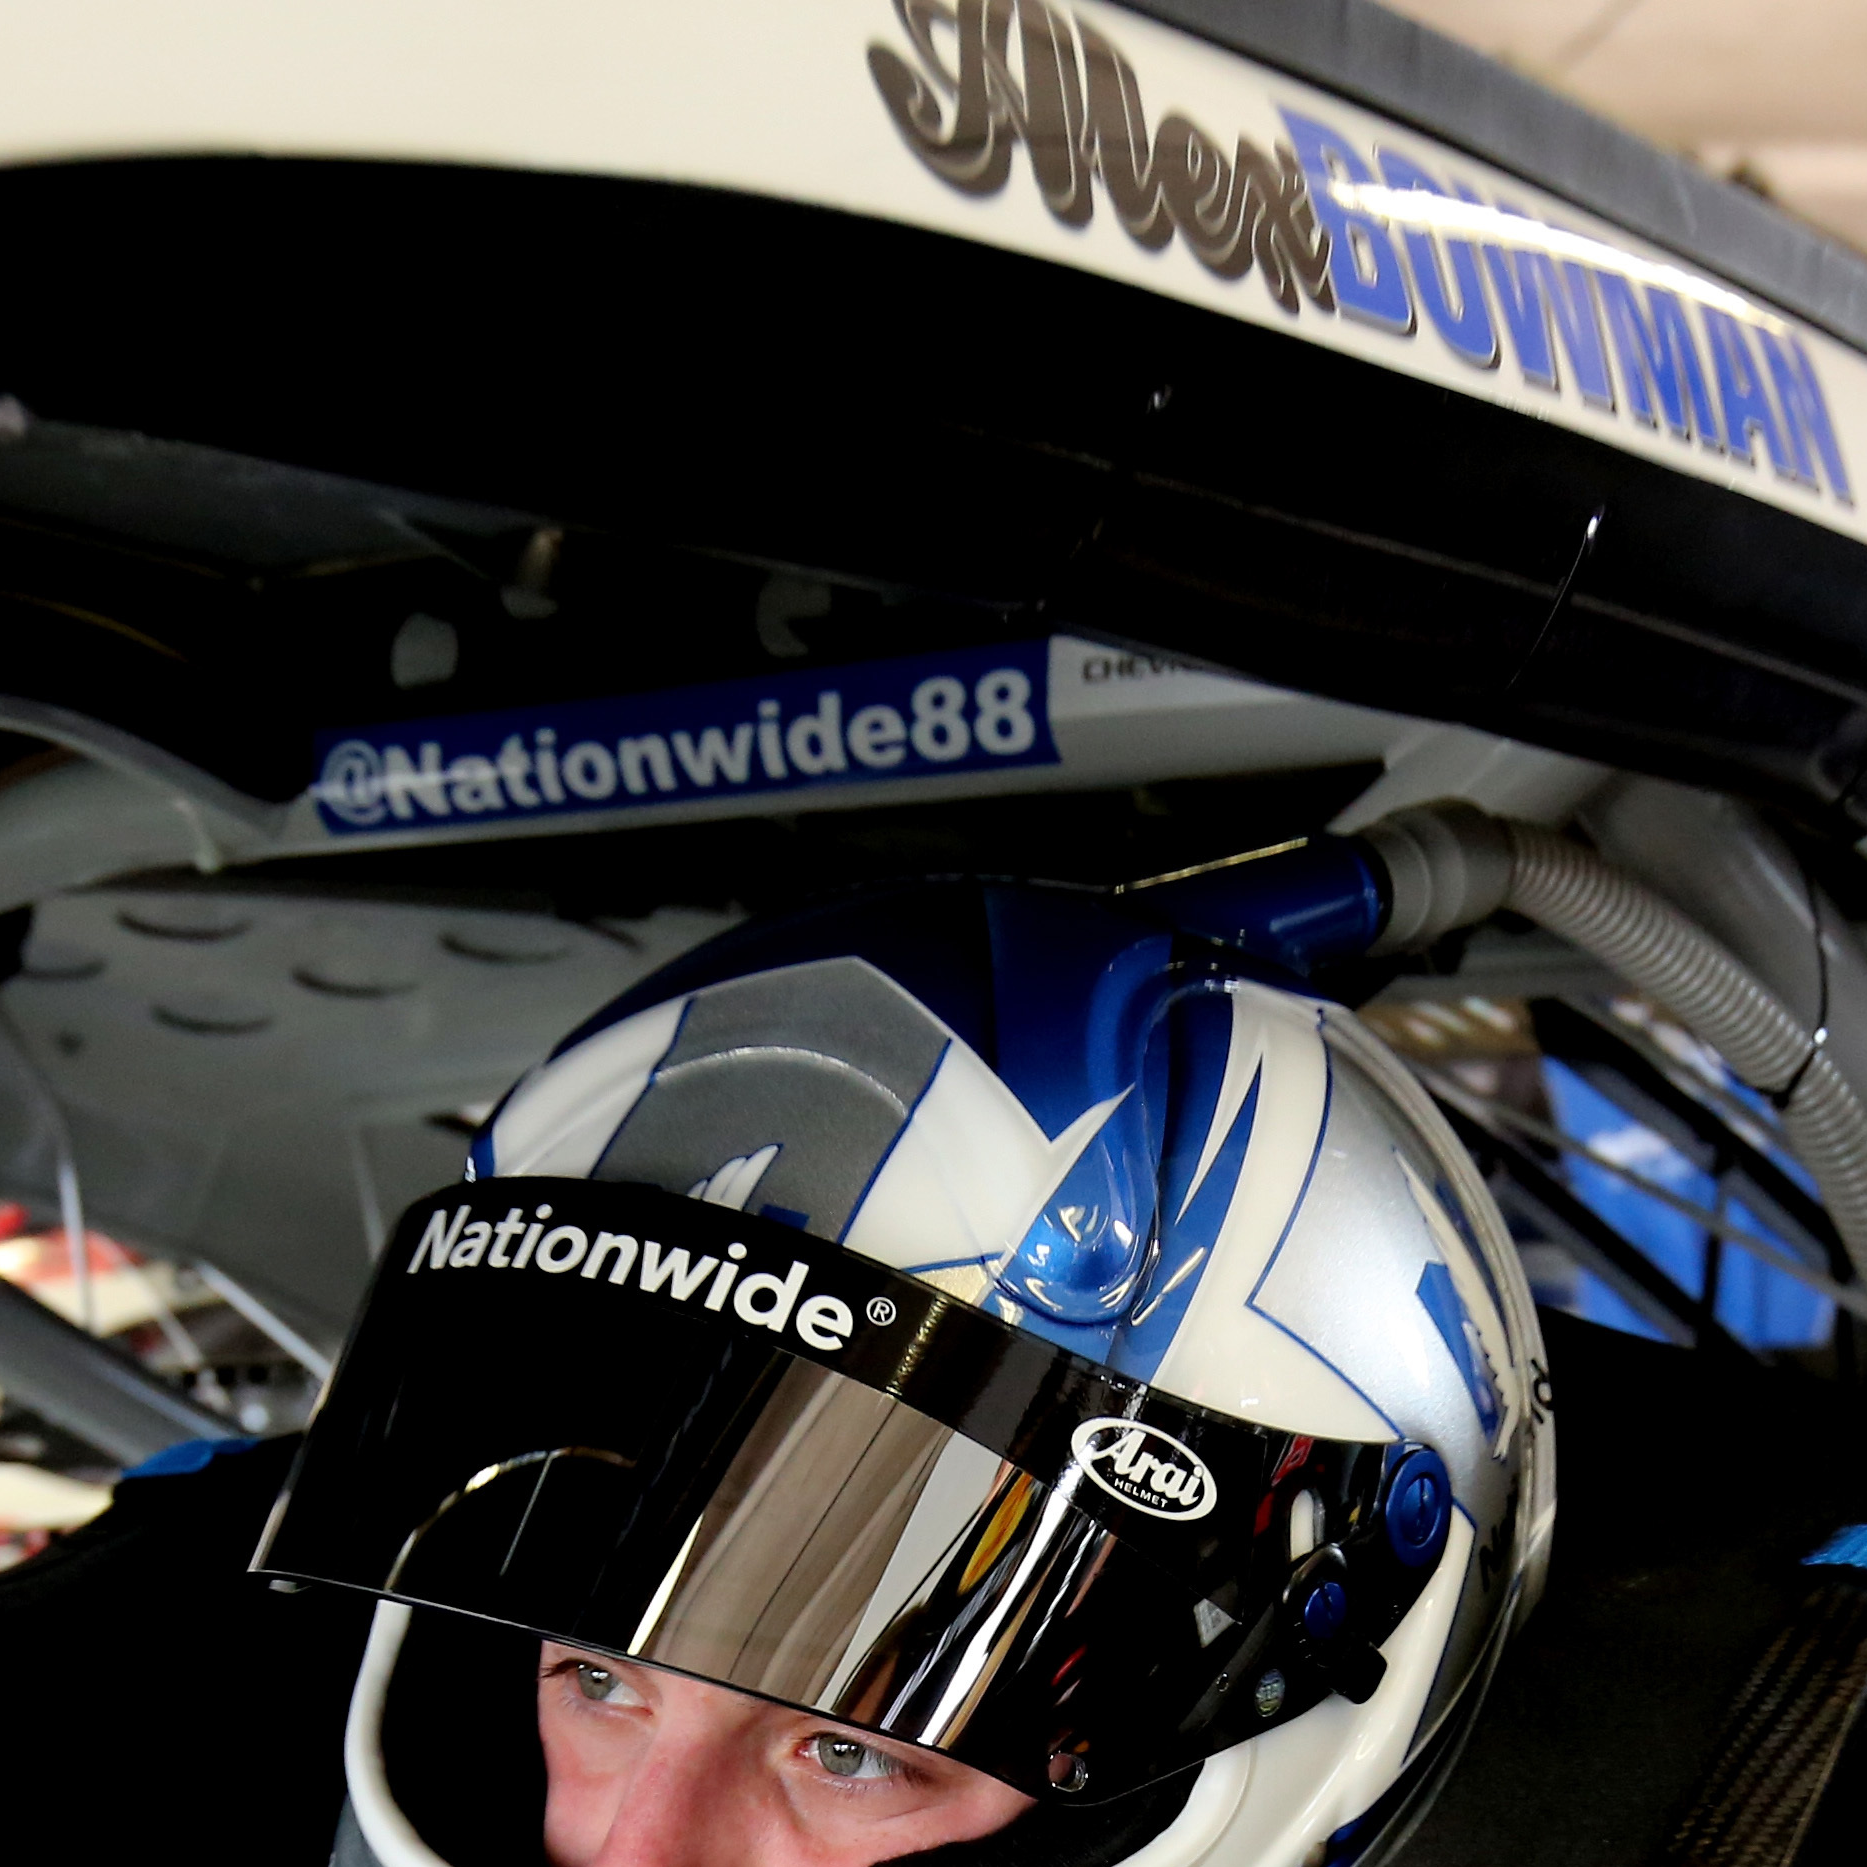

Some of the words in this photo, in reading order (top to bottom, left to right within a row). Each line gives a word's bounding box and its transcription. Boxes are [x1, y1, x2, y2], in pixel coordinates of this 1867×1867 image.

[866, 0, 1334, 315] Alex
[1273, 100, 1857, 508] BOWMAN
[317, 667, 1039, 828] @Nationwide88
[1089, 1428, 1204, 1506] Arai
[1114, 1477, 1169, 1508] HELMET
